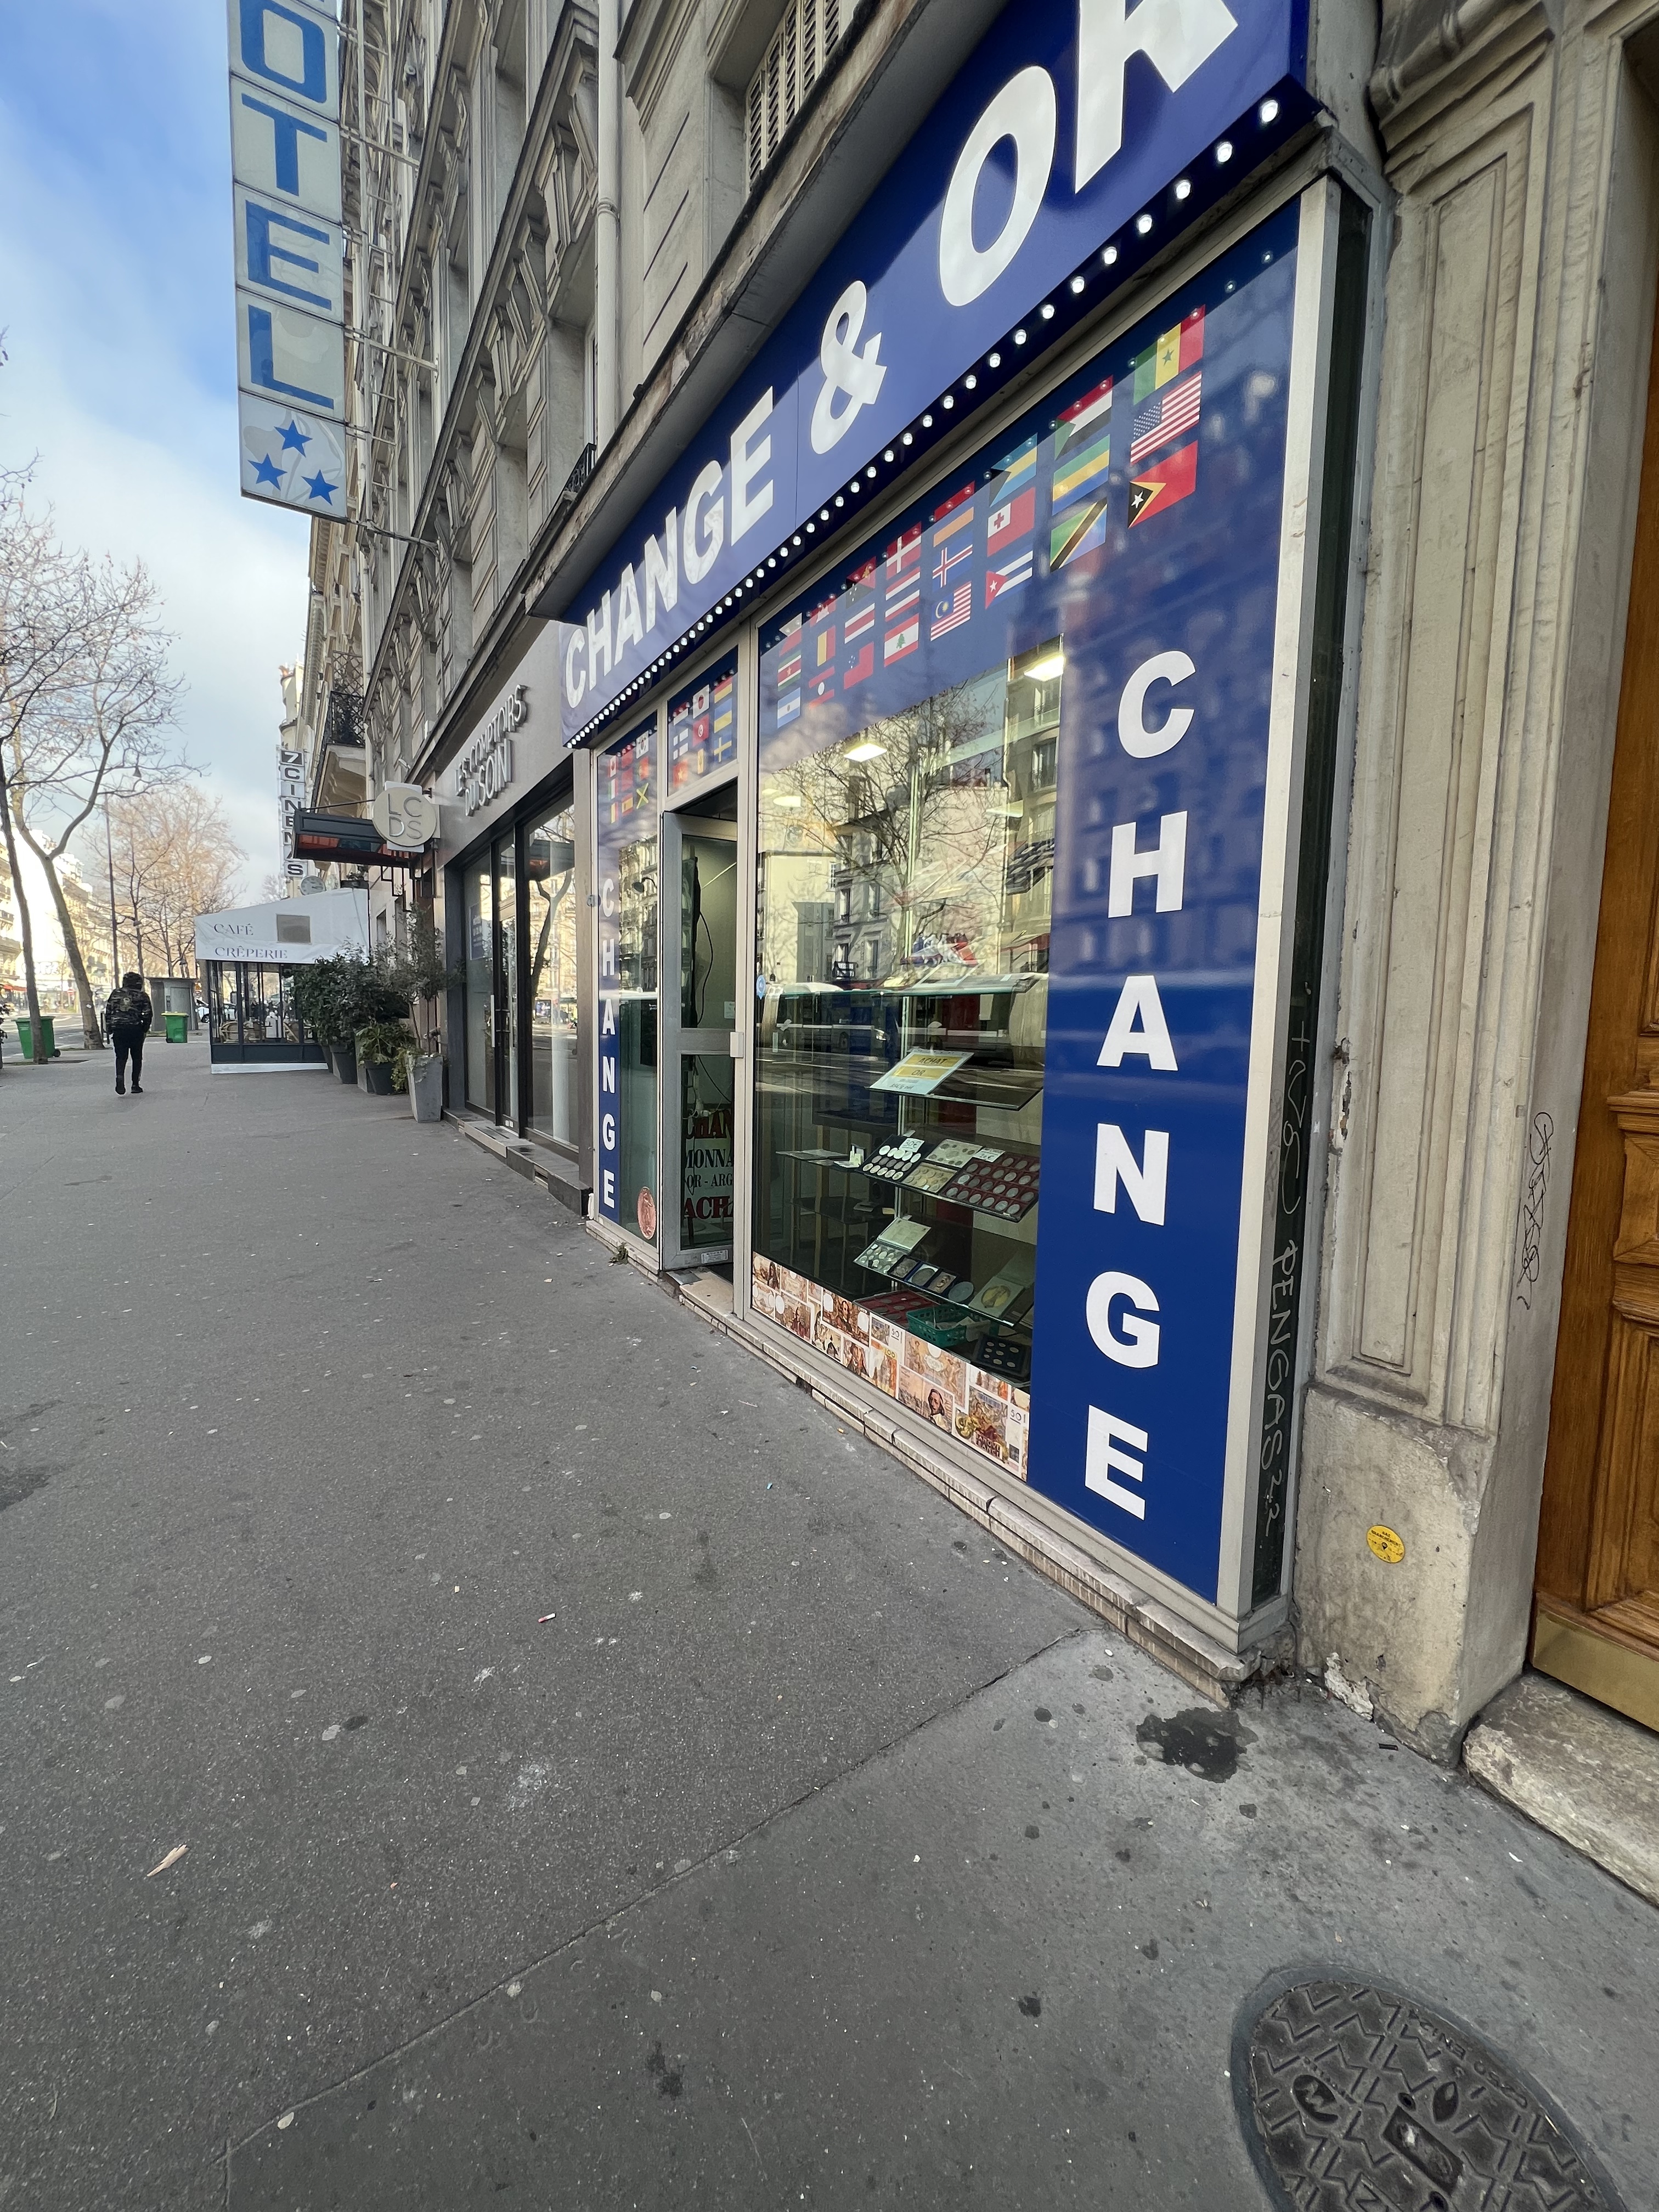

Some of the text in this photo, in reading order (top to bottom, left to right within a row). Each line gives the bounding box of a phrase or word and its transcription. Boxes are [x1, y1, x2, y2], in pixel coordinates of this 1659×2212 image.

[239, 0, 336, 410] OTEL
[565, 385, 774, 709] CHANGE
[809, 279, 889, 455] &
[470, 684, 526, 773] COMPTOIRS
[284, 752, 304, 876] 7 CINES
[465, 738, 513, 816] DU SOIN
[213, 923, 254, 936] CAFÉ
[215, 945, 288, 960] CRÊPERIE
[601, 878, 616, 1209] CHANGE
[1085, 650, 1197, 1521] CHANGE
[684, 1195, 733, 1220] ACH
[686, 1173, 702, 1188] OR
[884, 1347, 896, 1358] 100
[1009, 1409, 1022, 1421] 50
